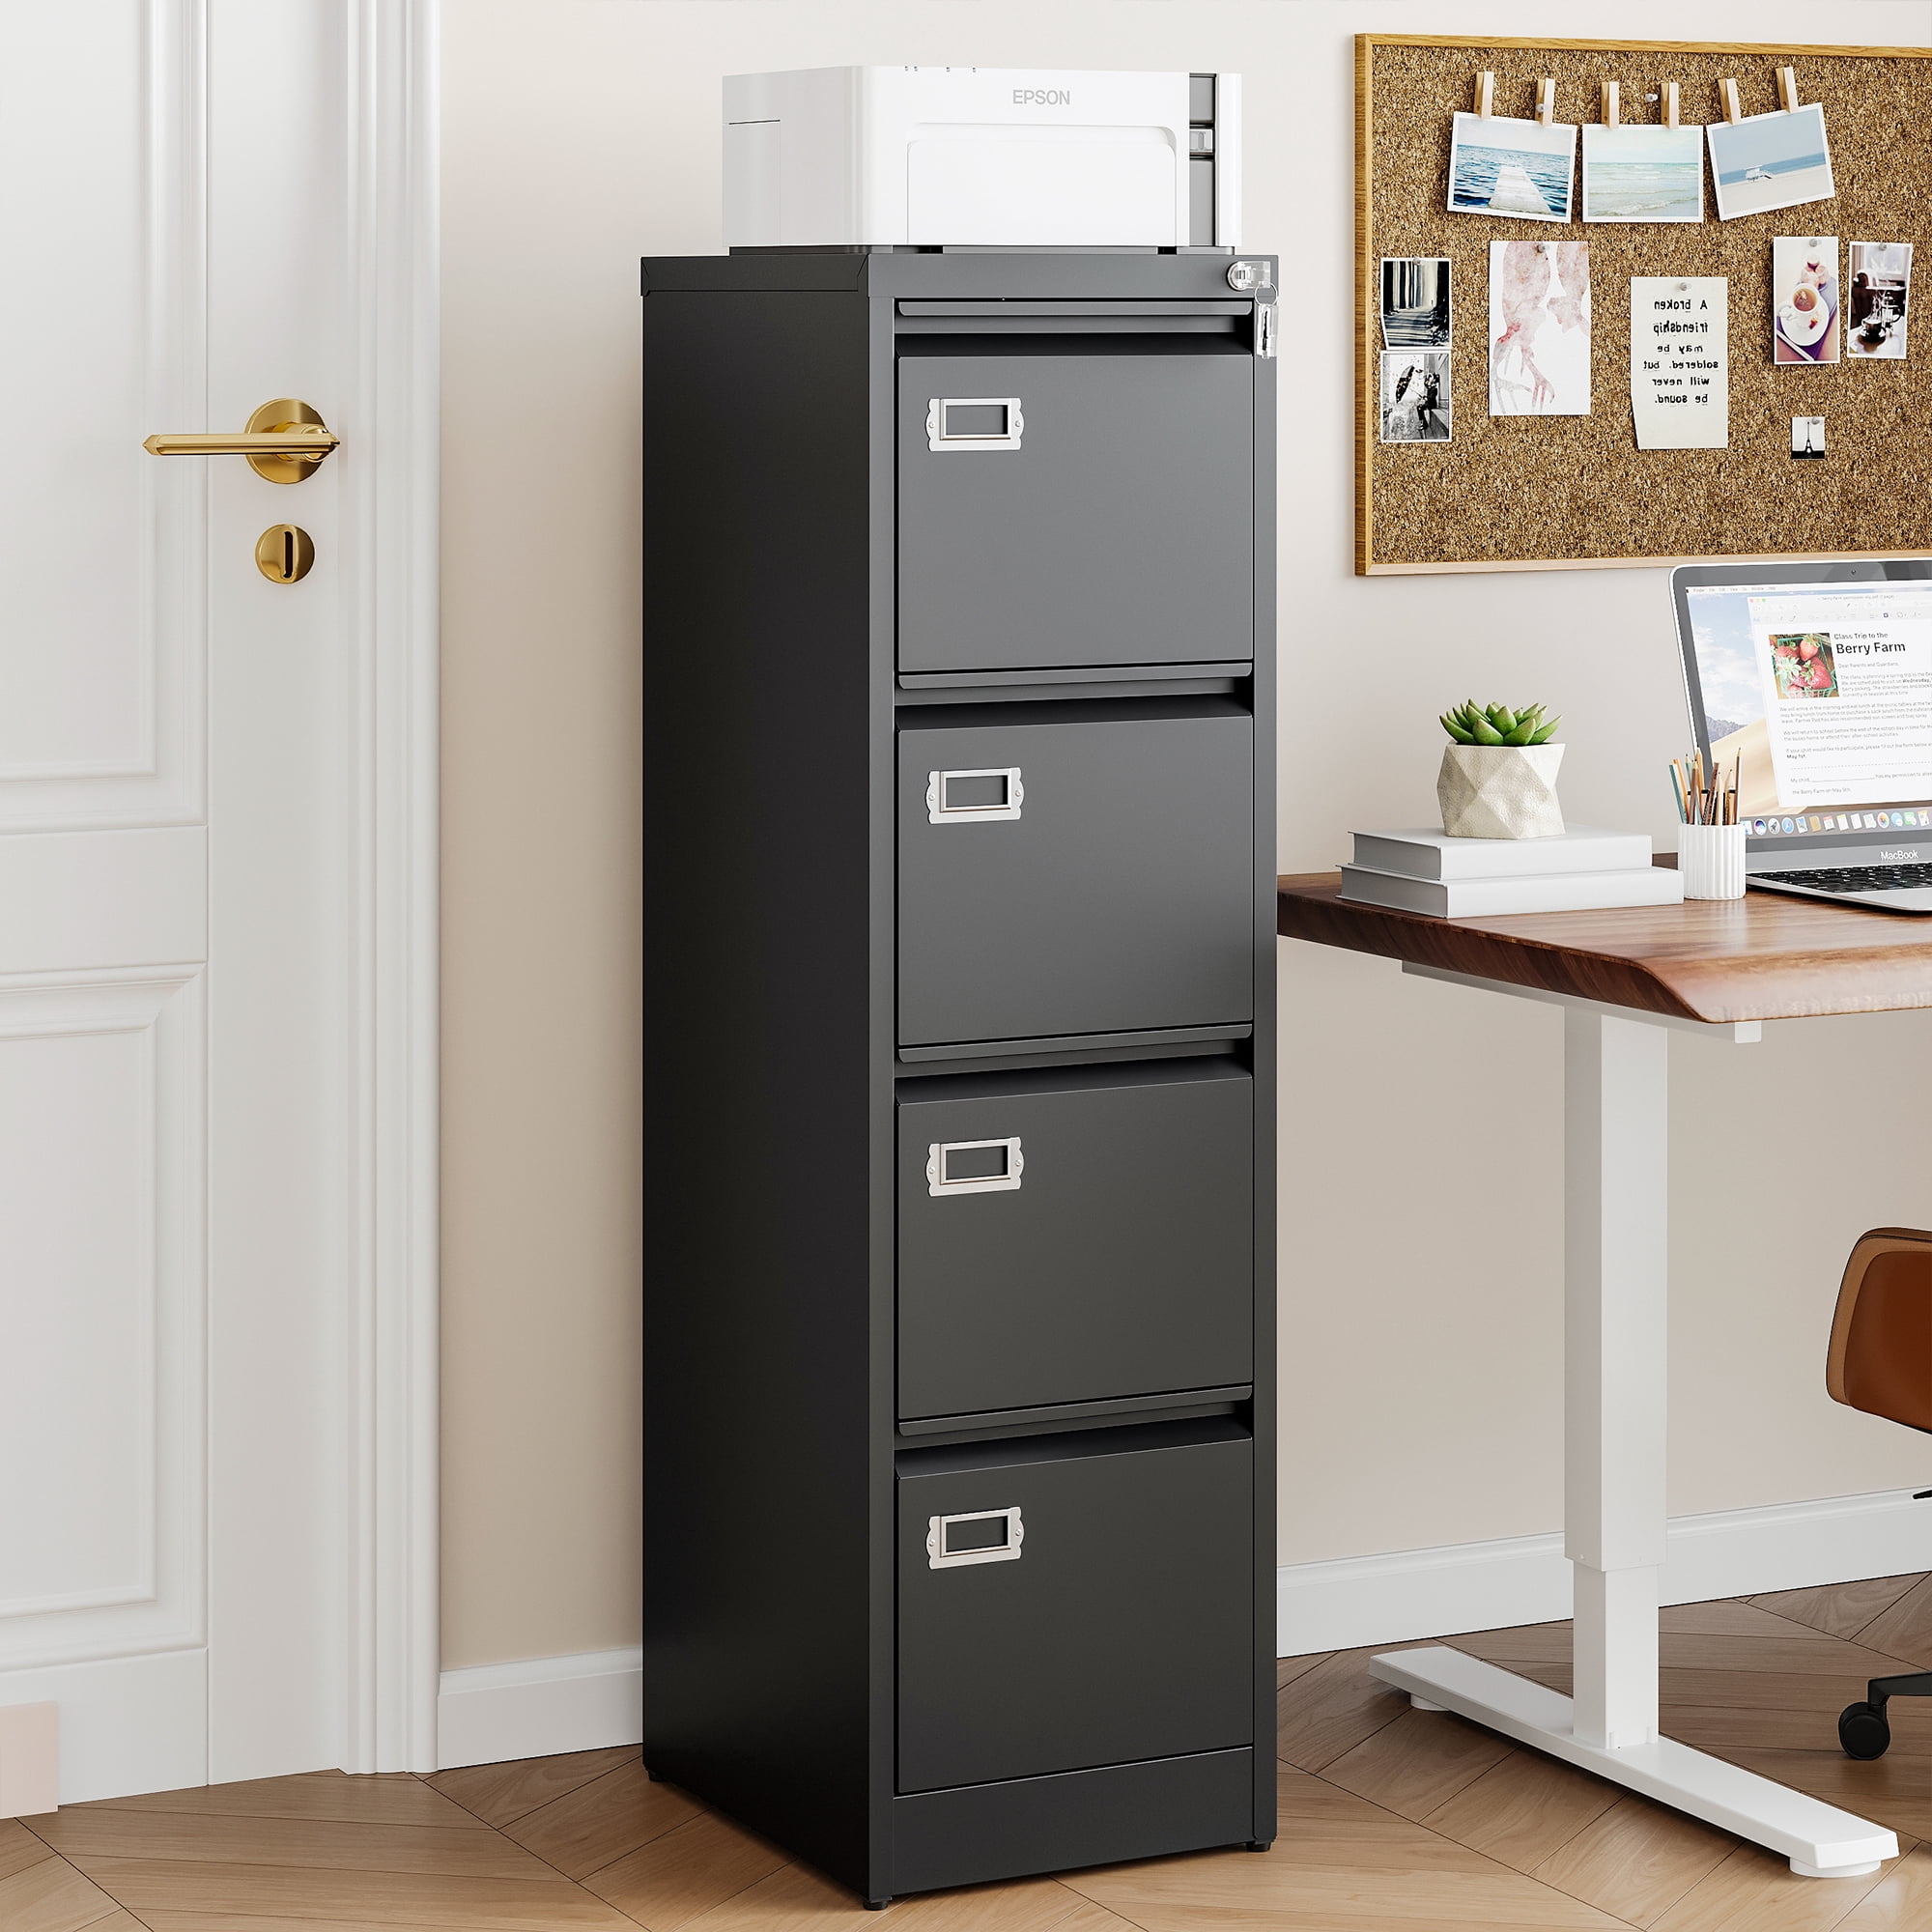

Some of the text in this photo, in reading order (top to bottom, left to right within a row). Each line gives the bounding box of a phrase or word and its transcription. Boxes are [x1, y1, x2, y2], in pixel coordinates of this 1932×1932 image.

[1013, 89, 1070, 105] EPSON
[1836, 642, 1906, 655] Berry Farm
[1880, 850, 1919, 861] MacBook
